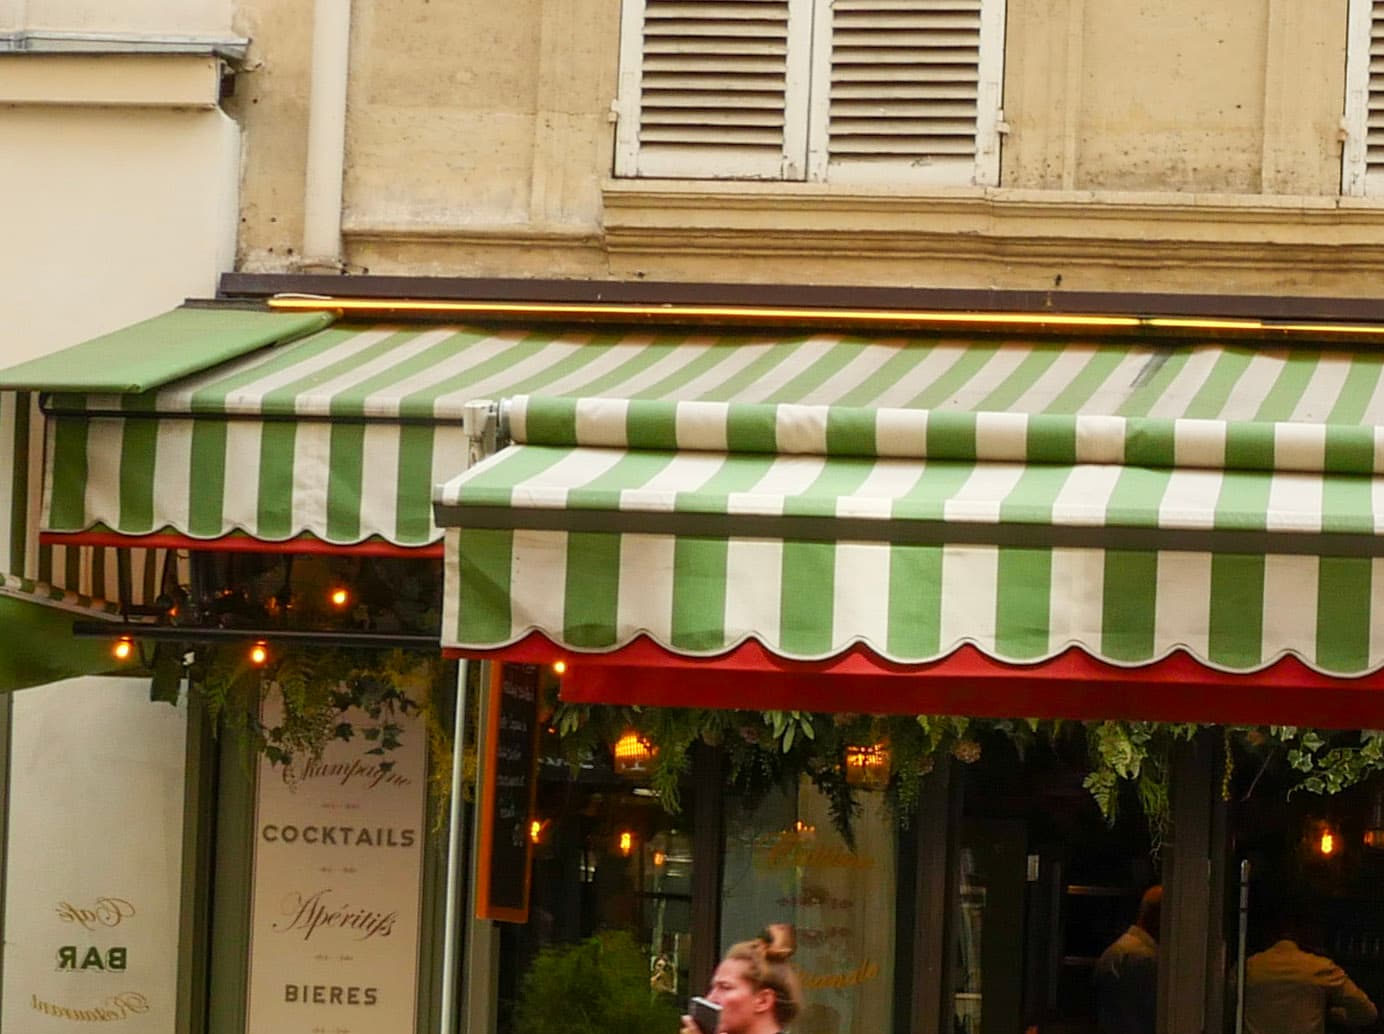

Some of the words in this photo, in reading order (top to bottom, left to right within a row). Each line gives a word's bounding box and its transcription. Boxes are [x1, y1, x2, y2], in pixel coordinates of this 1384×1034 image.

[262, 824, 416, 848] COCKTAILS
[272, 888, 398, 941] Apéritifs
[284, 984, 377, 1006] BIERES
